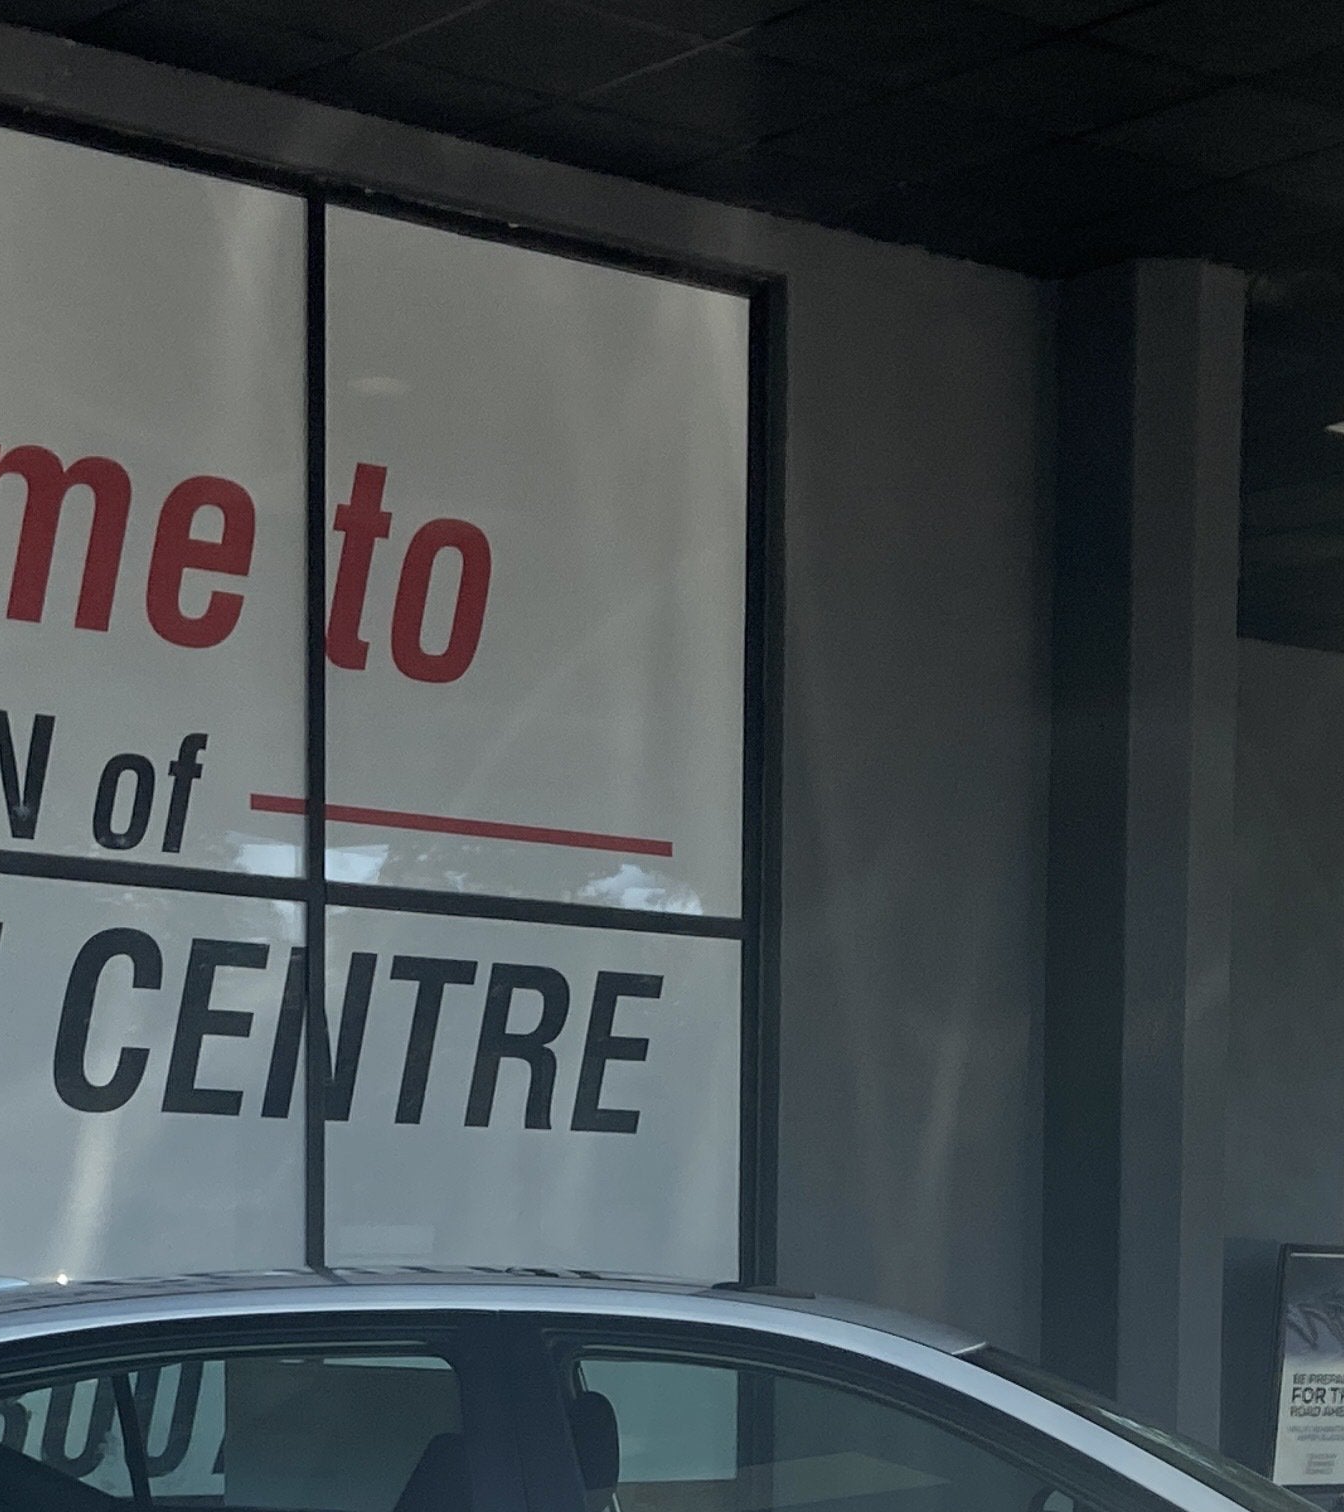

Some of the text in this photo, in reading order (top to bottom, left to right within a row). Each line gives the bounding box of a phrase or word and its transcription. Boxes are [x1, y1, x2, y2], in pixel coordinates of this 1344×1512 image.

[324, 462, 492, 684] to
[91, 733, 208, 854] of
[52, 926, 664, 1134] CENTRE
[1292, 1387, 1327, 1404] FOR
